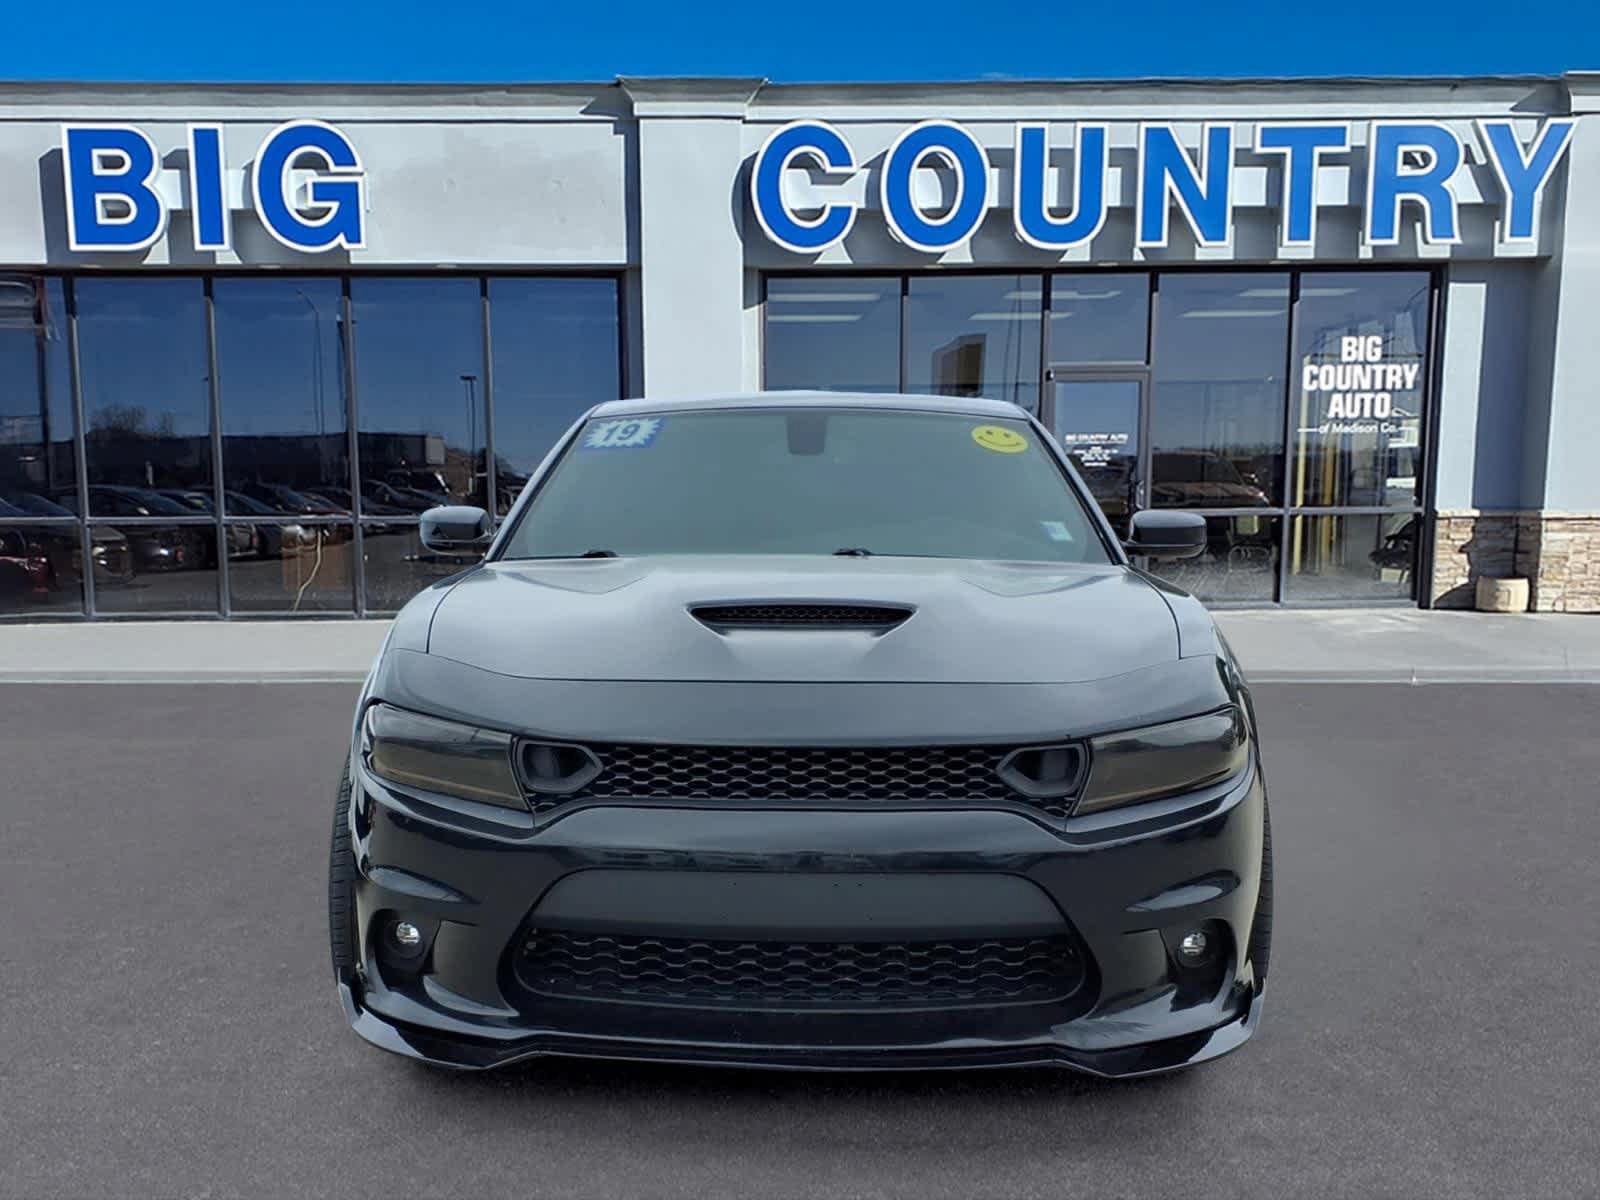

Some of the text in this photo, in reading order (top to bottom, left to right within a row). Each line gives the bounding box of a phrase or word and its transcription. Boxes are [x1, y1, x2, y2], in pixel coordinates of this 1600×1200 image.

[61, 118, 1575, 254] BIG COUNTRY
[1341, 336, 1382, 362] BIG
[1303, 363, 1419, 391] COUNTRY
[1327, 392, 1392, 419] AUTO
[603, 423, 640, 441] 19
[1320, 422, 1330, 434] of
